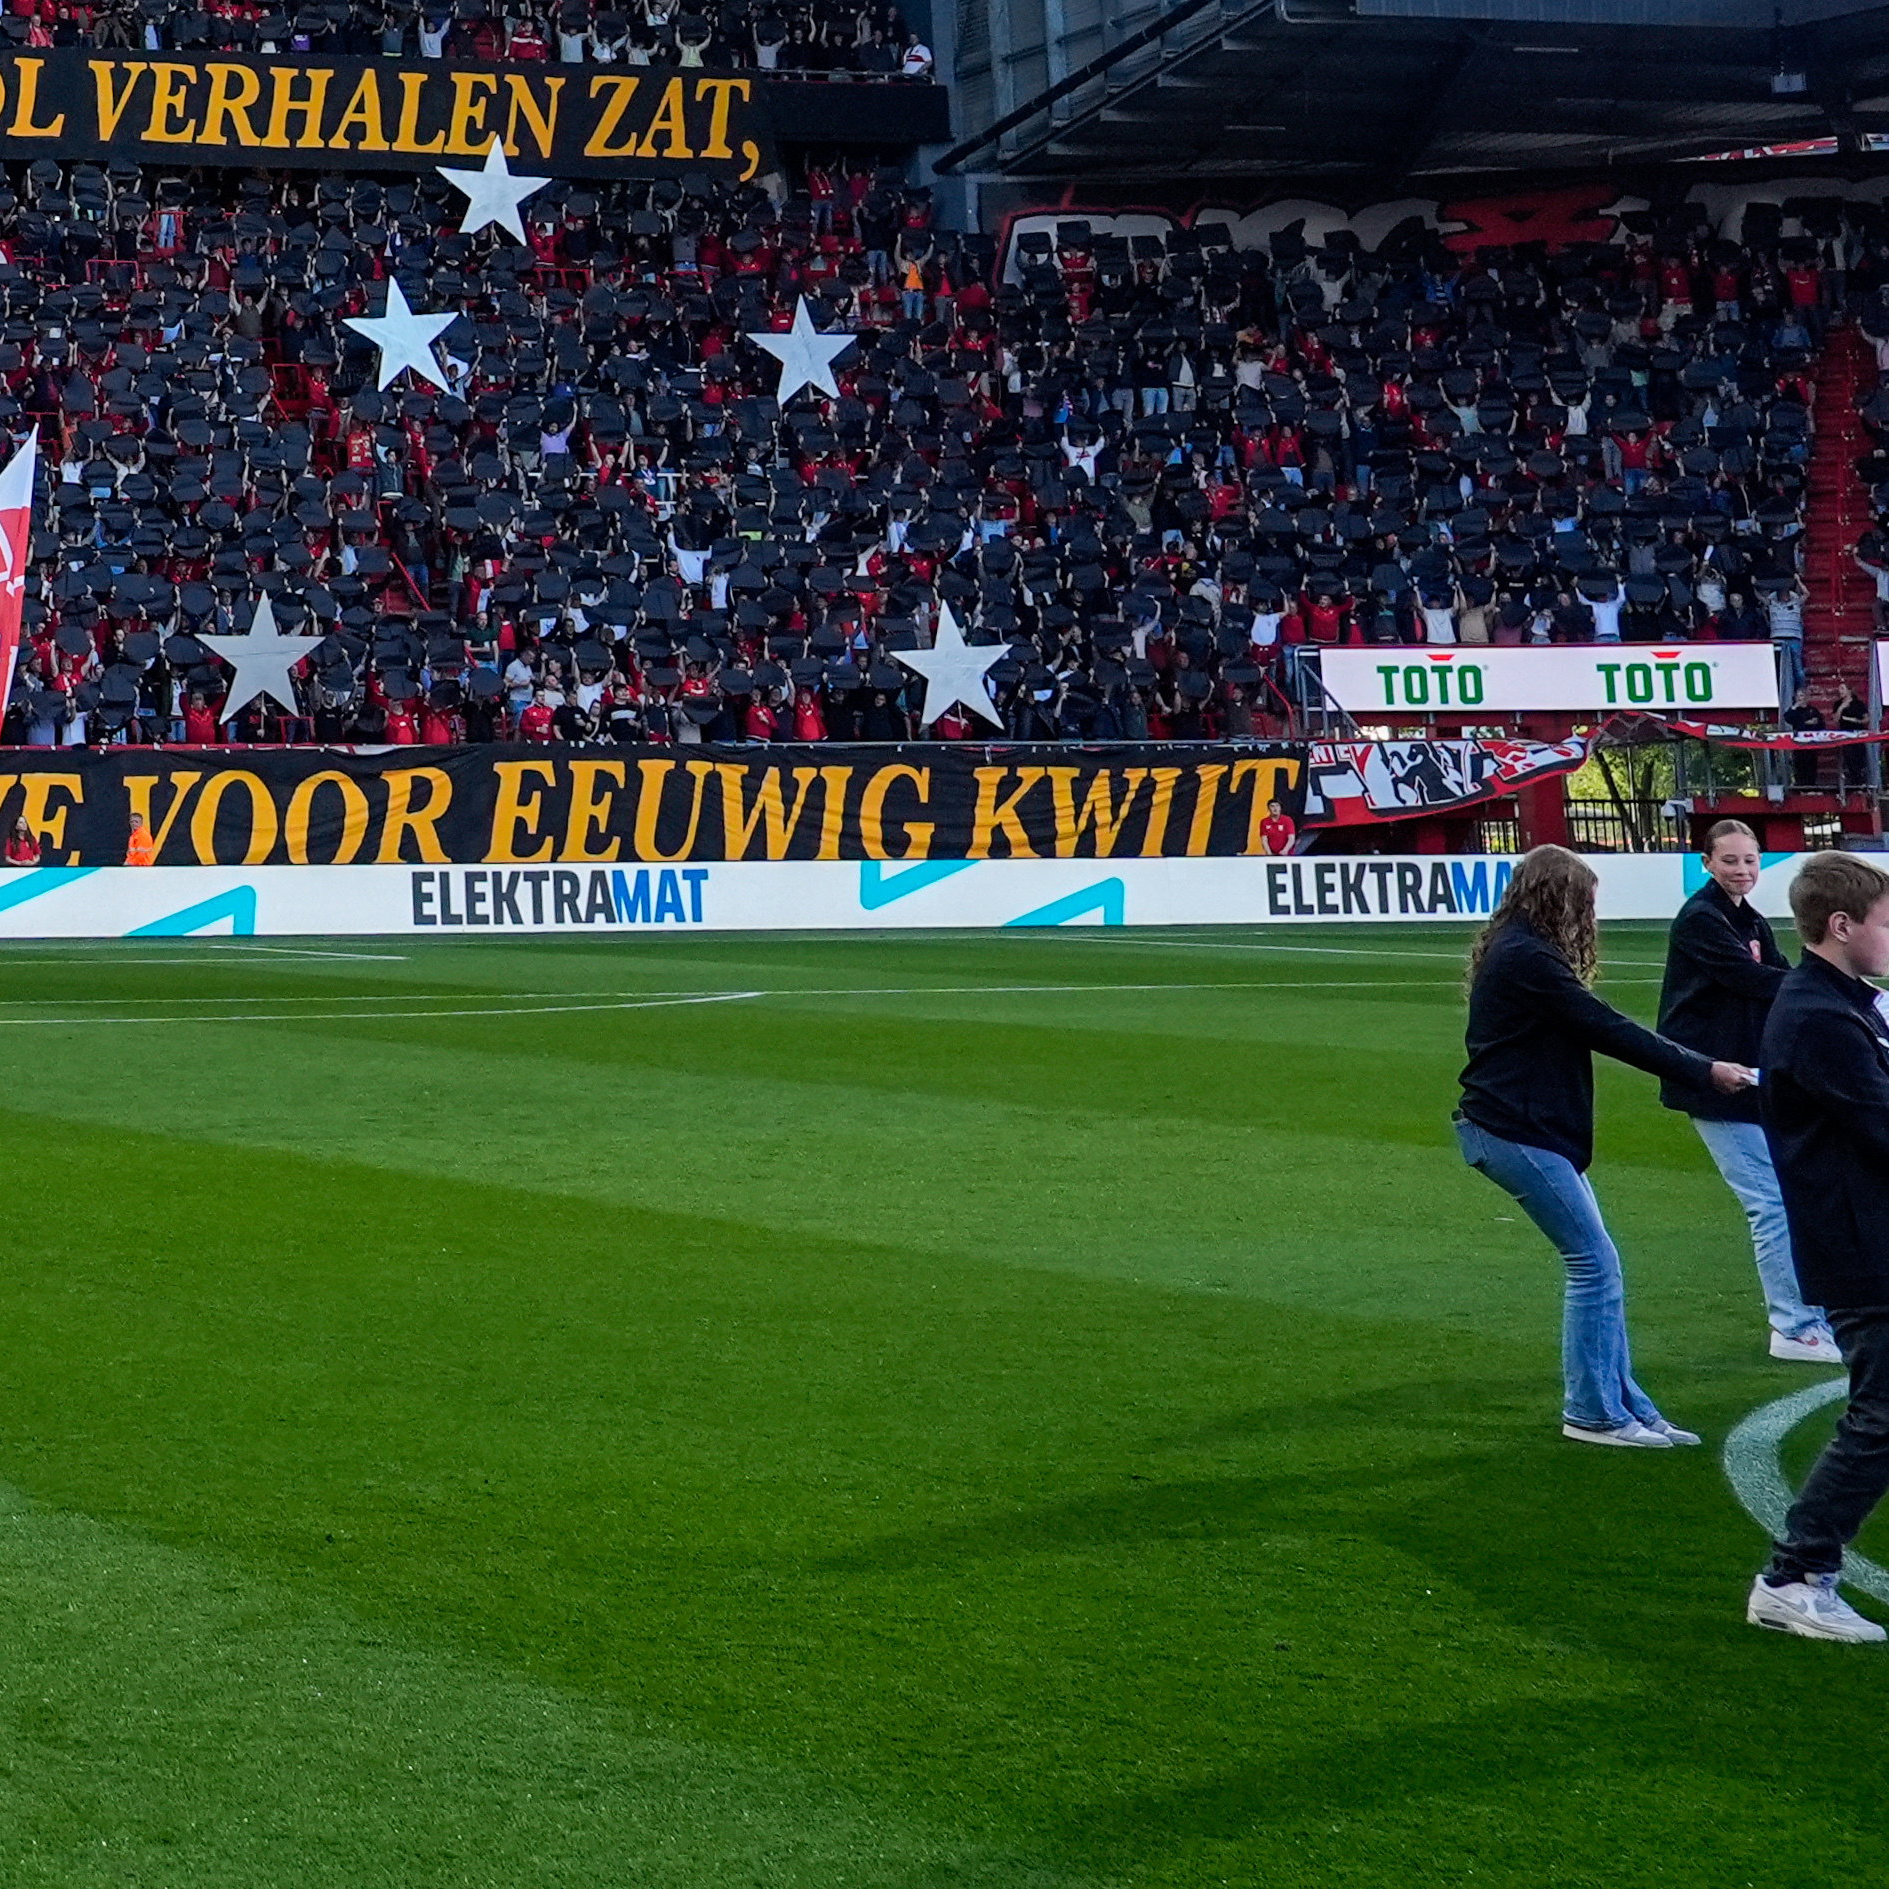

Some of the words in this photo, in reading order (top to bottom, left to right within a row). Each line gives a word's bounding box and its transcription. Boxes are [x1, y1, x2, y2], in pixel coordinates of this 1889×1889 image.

[89, 58, 564, 159] VERHALEN
[584, 75, 760, 182] ZAT,
[123, 767, 453, 866] VOOR
[481, 758, 933, 863] EEUWIG
[412, 869, 708, 926] ELEKTRAMAT
[1267, 860, 1523, 914] ELEKTRAMA
